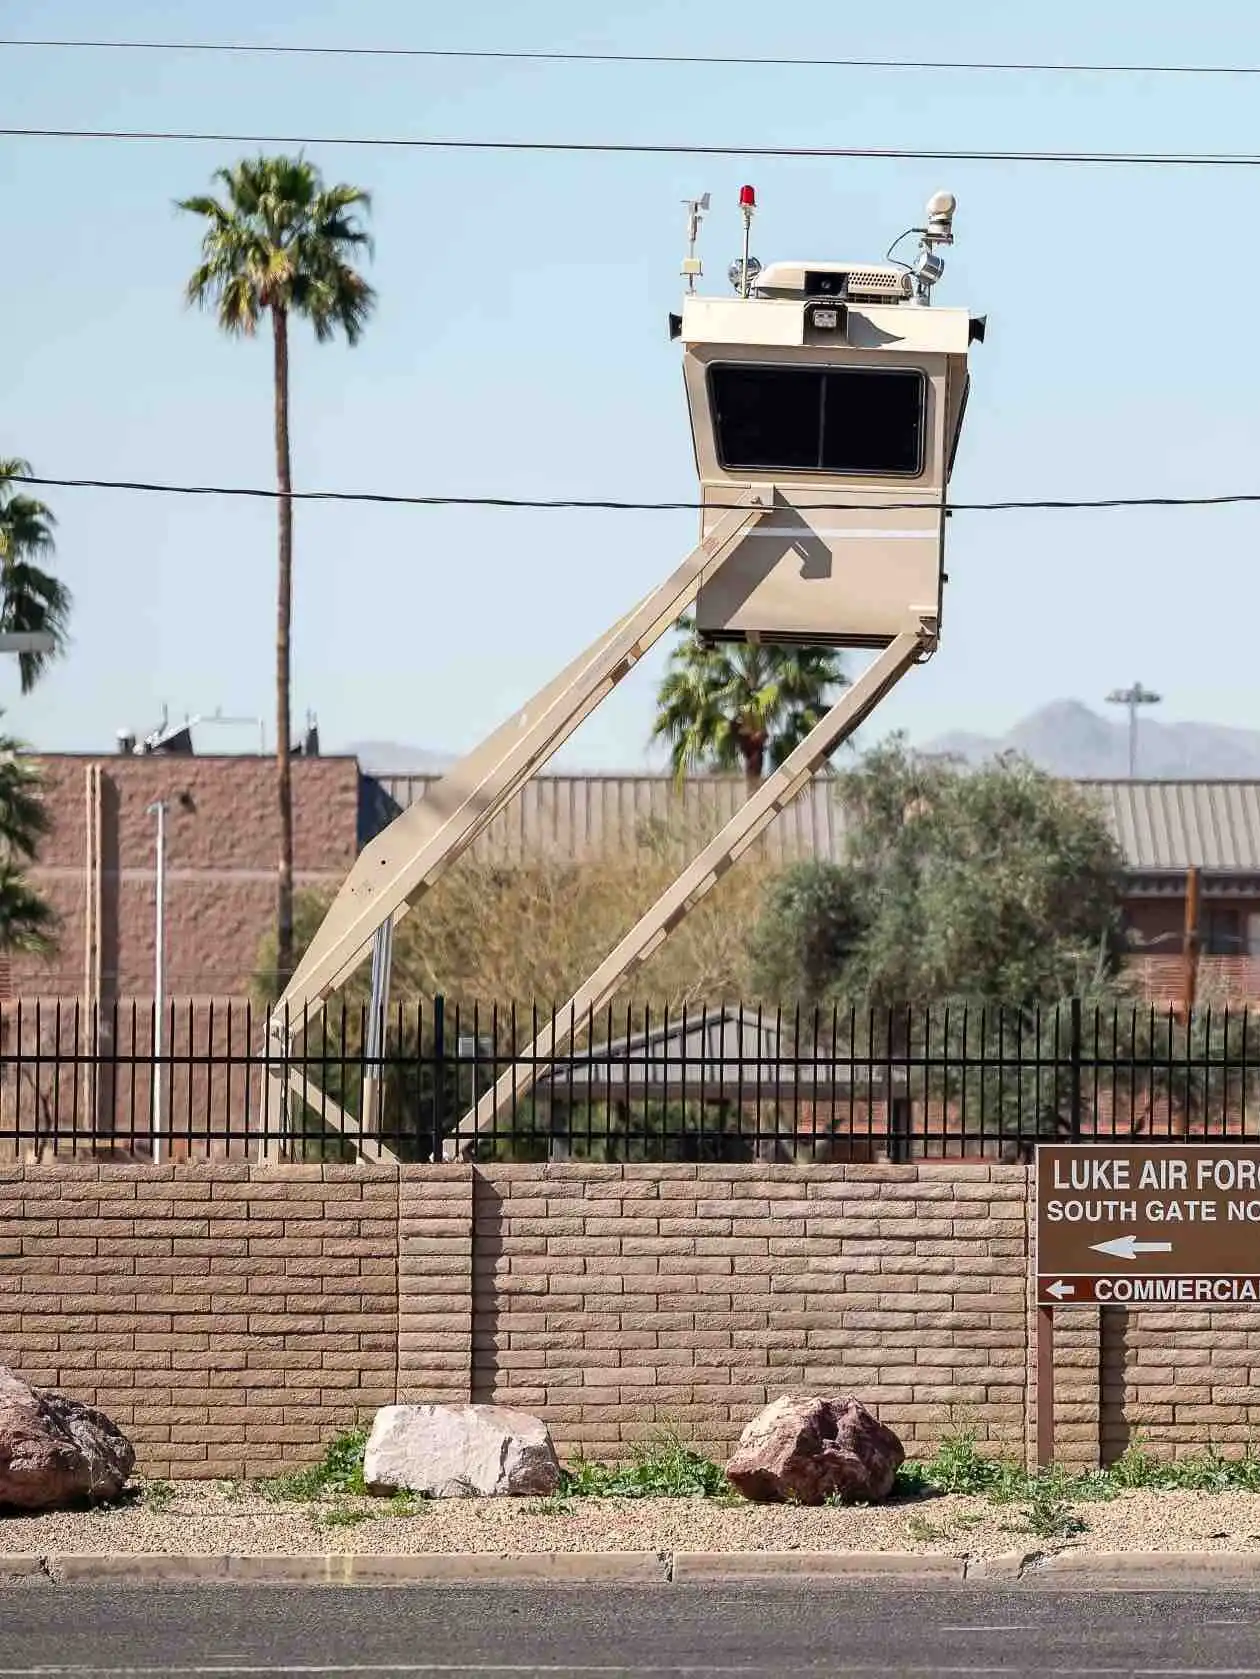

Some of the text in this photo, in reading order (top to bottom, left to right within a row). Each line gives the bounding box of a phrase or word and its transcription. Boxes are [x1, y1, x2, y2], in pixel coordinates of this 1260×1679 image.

[1053, 1159, 1130, 1190] LUKE
[1138, 1159, 1187, 1190] AIR
[1047, 1200, 1217, 1222] SOUTH GATE
